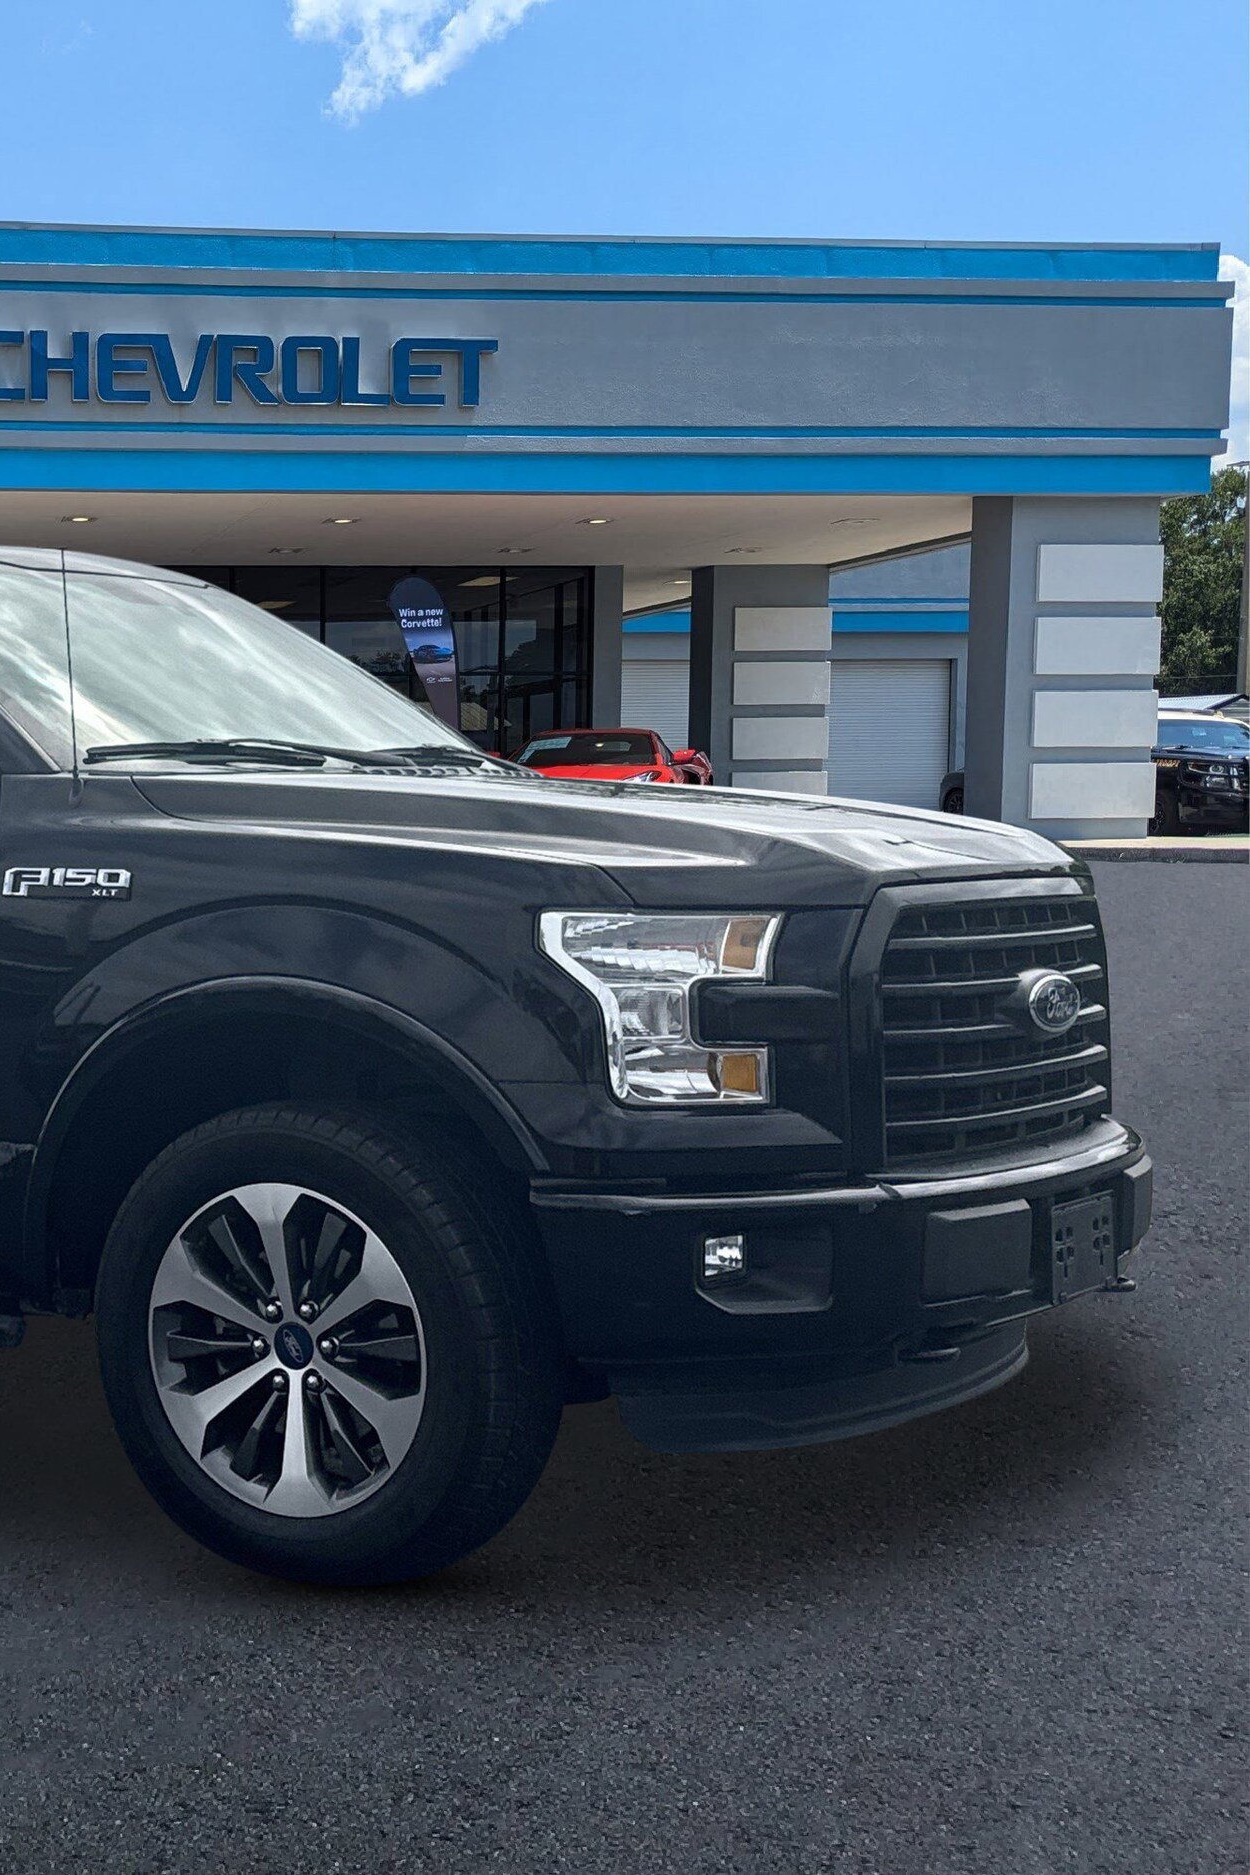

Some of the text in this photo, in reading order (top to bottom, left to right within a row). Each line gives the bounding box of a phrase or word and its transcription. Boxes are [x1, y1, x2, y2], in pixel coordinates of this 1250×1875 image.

[399, 608, 444, 617] Win a new
[401, 618, 442, 628] Corvette!
[2, 866, 132, 897] F150
[91, 888, 119, 897] XLT
